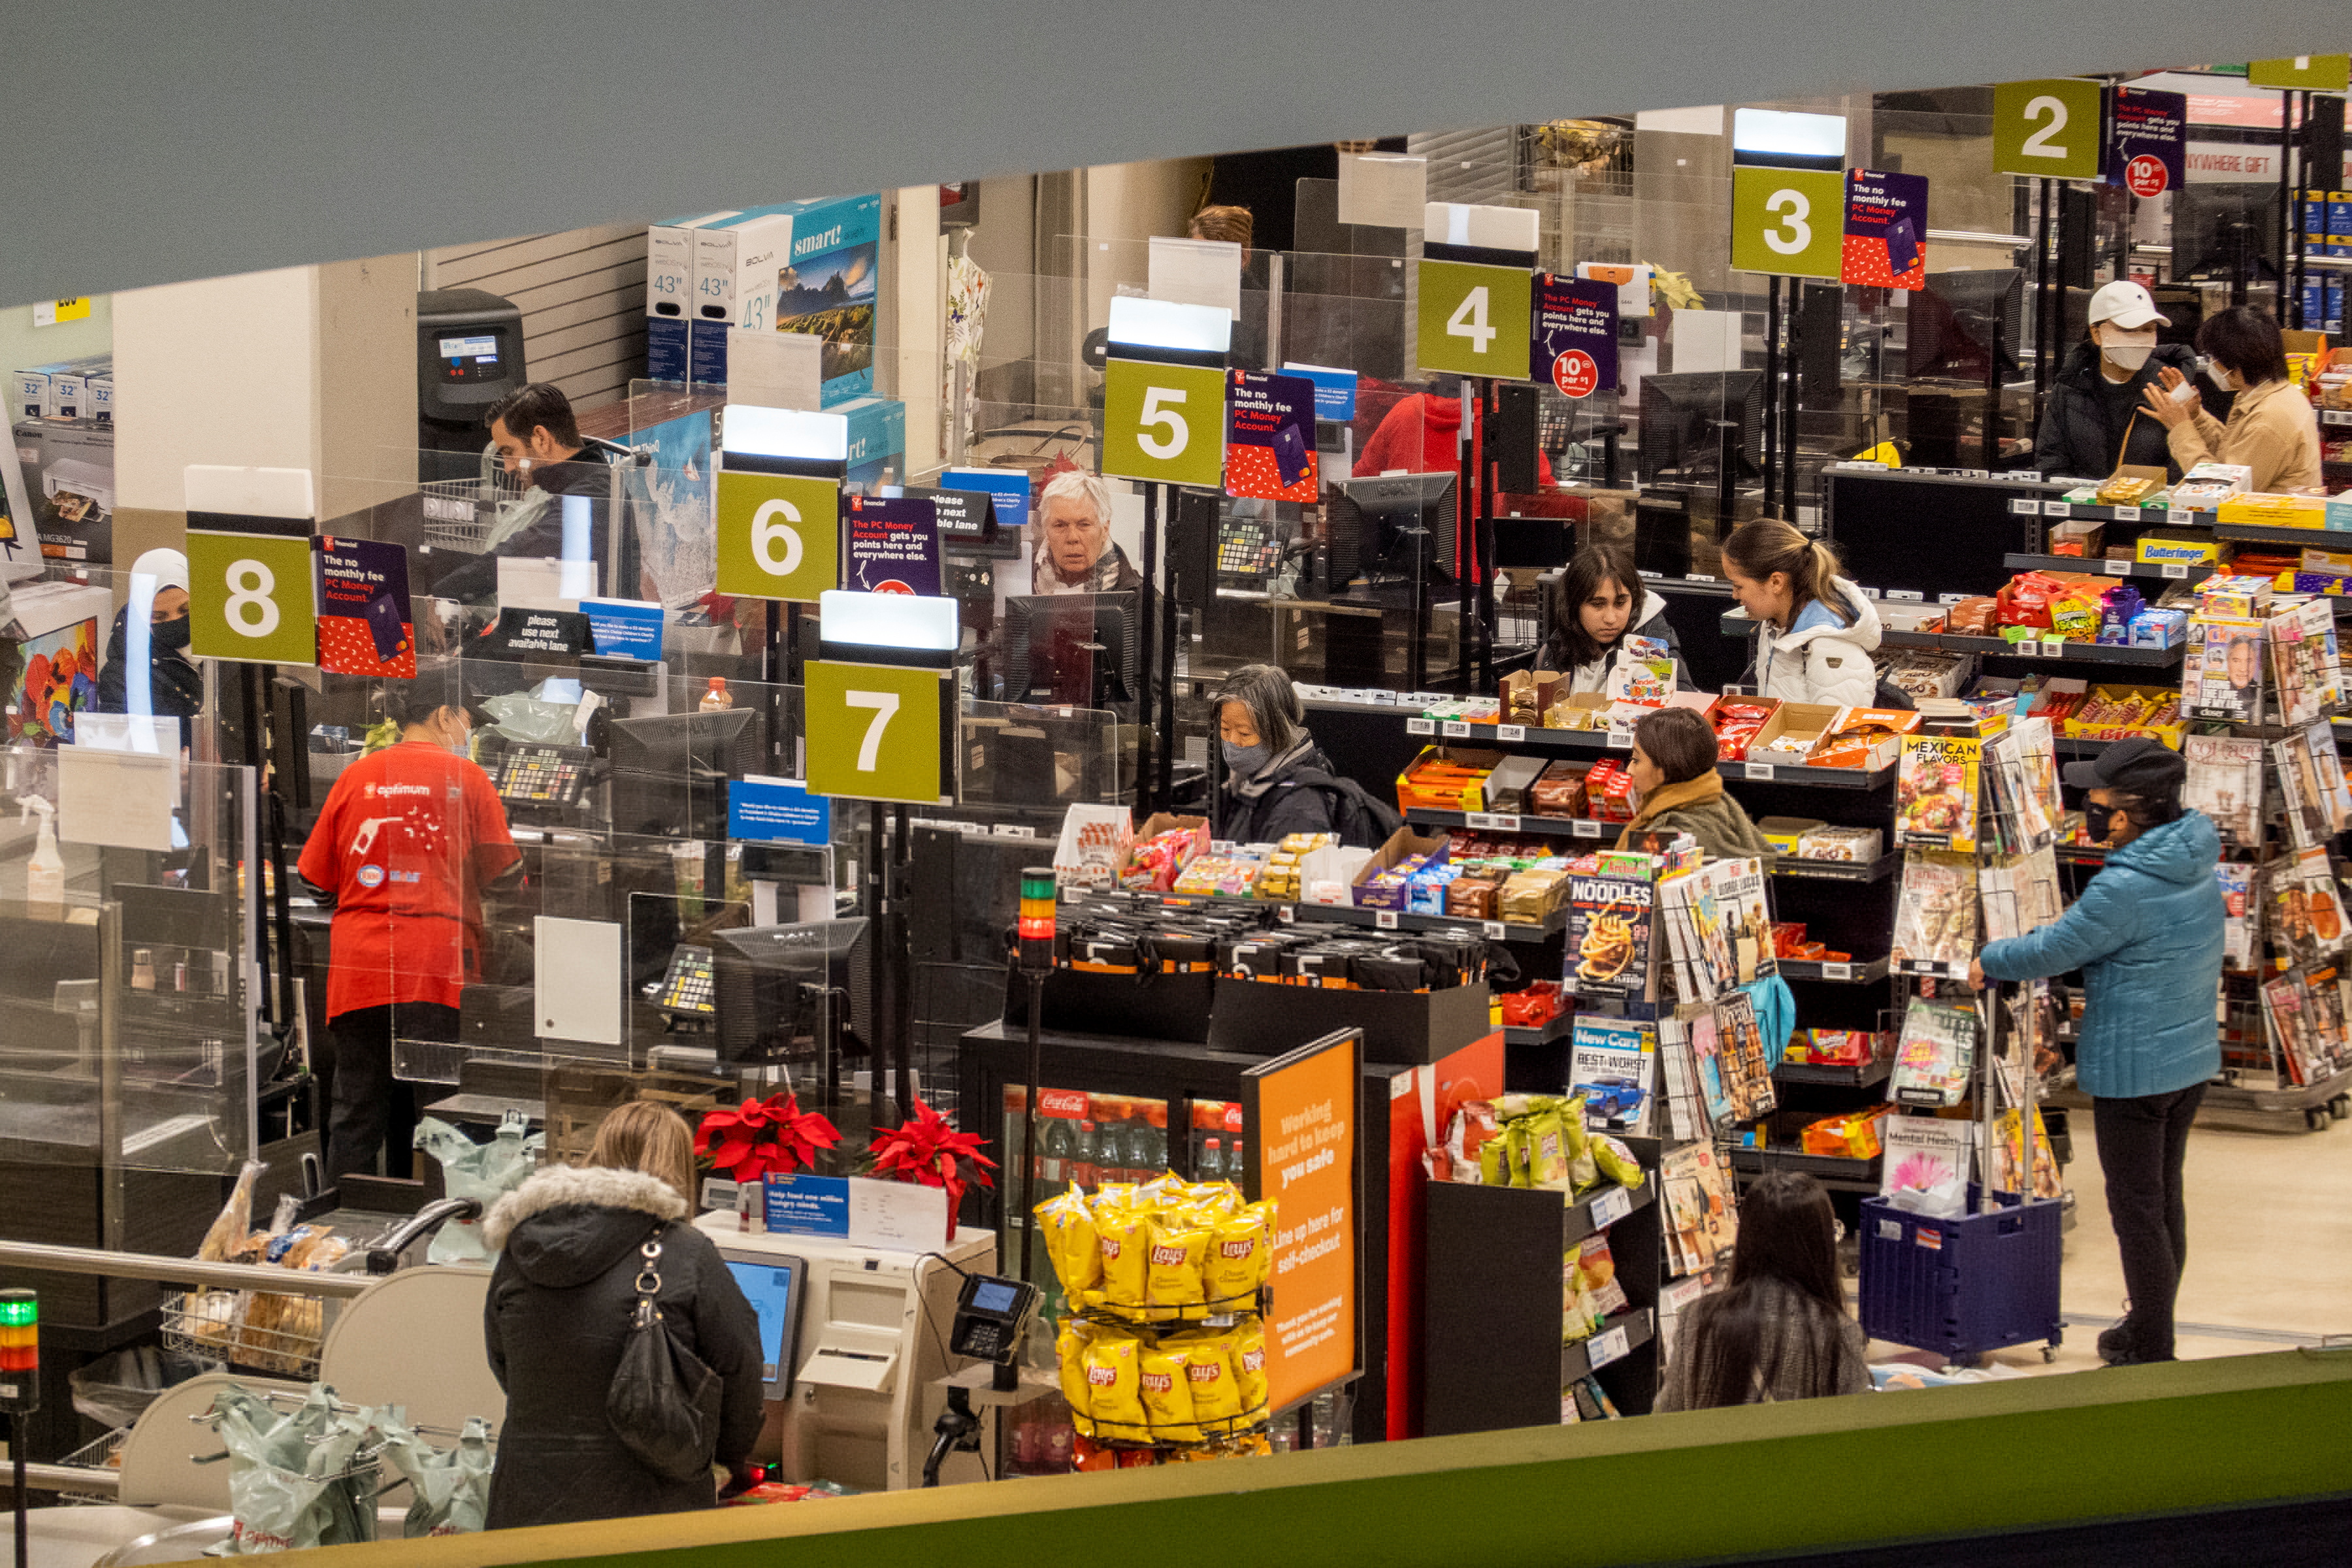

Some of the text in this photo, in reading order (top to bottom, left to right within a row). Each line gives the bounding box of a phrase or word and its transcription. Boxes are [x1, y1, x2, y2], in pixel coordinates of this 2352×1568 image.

[2021, 95, 2068, 158] 2
[2117, 121, 2140, 129] points
[2141, 123, 2159, 131] here
[2116, 129, 2159, 139] everywhere
[2132, 161, 2152, 178] 10
[2245, 157, 2270, 174] GIFT
[2134, 178, 2149, 187] per
[1854, 184, 1884, 195] The no
[1853, 195, 1906, 207] monthly fee
[1866, 205, 1897, 218] Money
[1764, 189, 1812, 255] 3
[1851, 214, 1890, 225] Account.
[794, 224, 841, 256] smart!
[1544, 293, 1558, 302] The
[1571, 298, 1597, 308] Money
[1543, 303, 1609, 318] Account gets you
[1446, 286, 1496, 353] 4
[1543, 312, 1567, 321] points
[1569, 314, 1587, 323] here
[1542, 320, 1588, 332] everywhere
[1560, 357, 1581, 375] 10
[1561, 376, 1577, 385] per
[1235, 387, 1252, 397] The
[1234, 400, 1292, 412] monthly fee
[1137, 386, 1188, 459] 5
[1234, 410, 1281, 425] PC Money
[1234, 420, 1276, 432] Account.
[15, 429, 42, 438] Canon
[943, 508, 966, 517] next
[853, 520, 869, 529] The
[885, 522, 913, 532] Money
[955, 519, 978, 531] lane
[43, 533, 72, 544] MG3620
[751, 498, 803, 576] 6
[853, 531, 928, 542] Account gets you
[853, 540, 881, 550] points
[883, 541, 903, 550] here
[853, 551, 927, 561] everywhere else.
[2145, 545, 2206, 561] Butterfinger
[323, 555, 358, 567] The no
[324, 568, 385, 582] monthly fee
[325, 579, 374, 595] PC Money
[225, 559, 280, 638] 8
[326, 590, 370, 602] Account.
[527, 615, 557, 627] please
[2057, 618, 2089, 630] SOUR
[521, 627, 559, 639] use next
[508, 638, 568, 651] available lane
[1904, 684, 1925, 693] Aero
[2200, 708, 2225, 717] closer
[846, 690, 900, 772] 7
[1906, 741, 1977, 756] MEXICAN
[1916, 753, 1967, 765] FLAVORS
[376, 782, 431, 798] optimum
[1573, 881, 1652, 906] NOODLES
[1575, 1028, 1640, 1049] New Cars
[1281, 1098, 1332, 1135] Working
[1267, 1121, 1345, 1166] hard to keep
[1888, 1132, 1925, 1143] Mental
[1281, 1148, 1335, 1189] you safe
[1274, 1207, 1344, 1250] Line up here for
[1277, 1232, 1341, 1274] self-checkout
